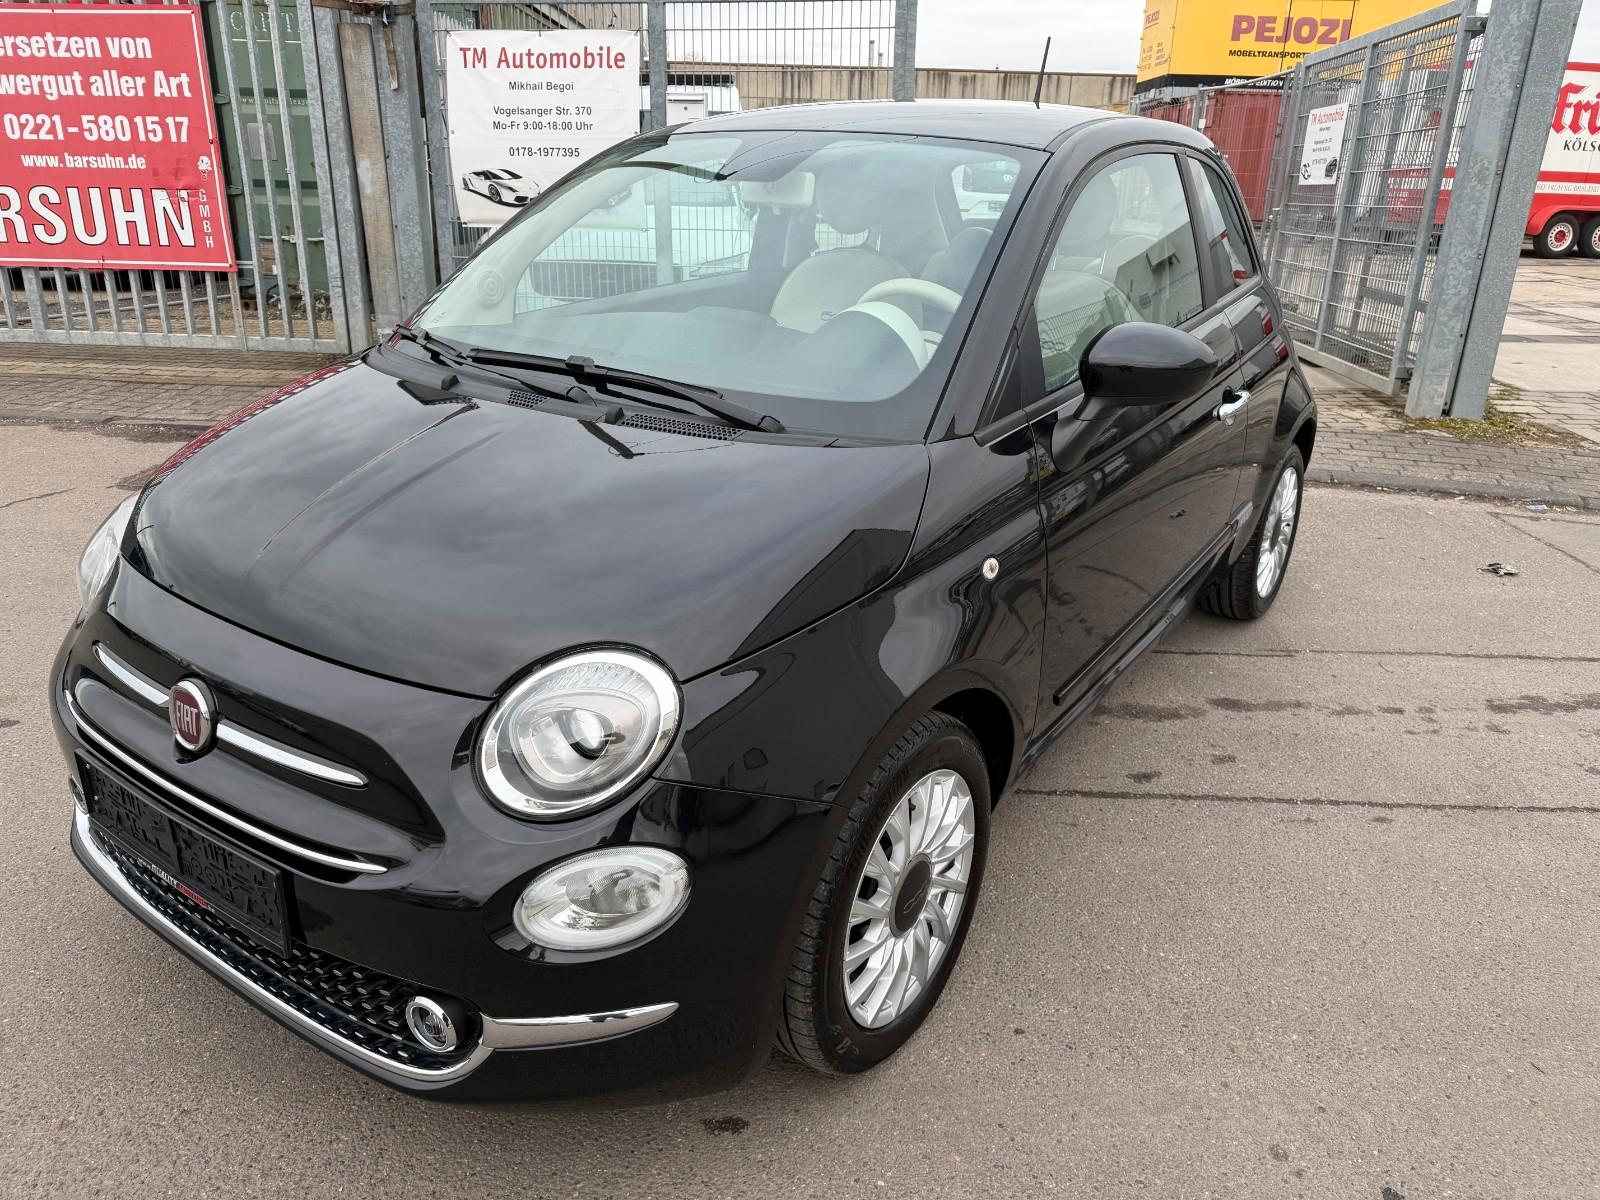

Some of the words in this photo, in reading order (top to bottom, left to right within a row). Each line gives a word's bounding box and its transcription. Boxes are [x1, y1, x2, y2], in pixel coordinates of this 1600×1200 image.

[1230, 15, 1352, 45] PEJOZI
[105, 36, 153, 59] von
[1228, 48, 1310, 59] MÖBELTRANSPORT
[459, 47, 487, 69] TM
[496, 45, 626, 69] Automobile
[89, 69, 146, 97] aller
[153, 70, 193, 98] Art
[508, 81, 543, 91] Mikhail
[546, 81, 574, 93] Begoi
[493, 105, 553, 118] Vogelsanger
[555, 106, 573, 116] Str.
[574, 106, 592, 116] 370
[492, 120, 521, 130] Mo-Fr
[522, 121, 573, 131] 9:00-18:00
[575, 121, 593, 131] Uhr
[508, 146, 580, 158] 0178-1977395
[1563, 137, 1600, 152] KÖLS
[20, 152, 147, 170] www.barsuhn.de
[176, 700, 199, 736] FIAT
